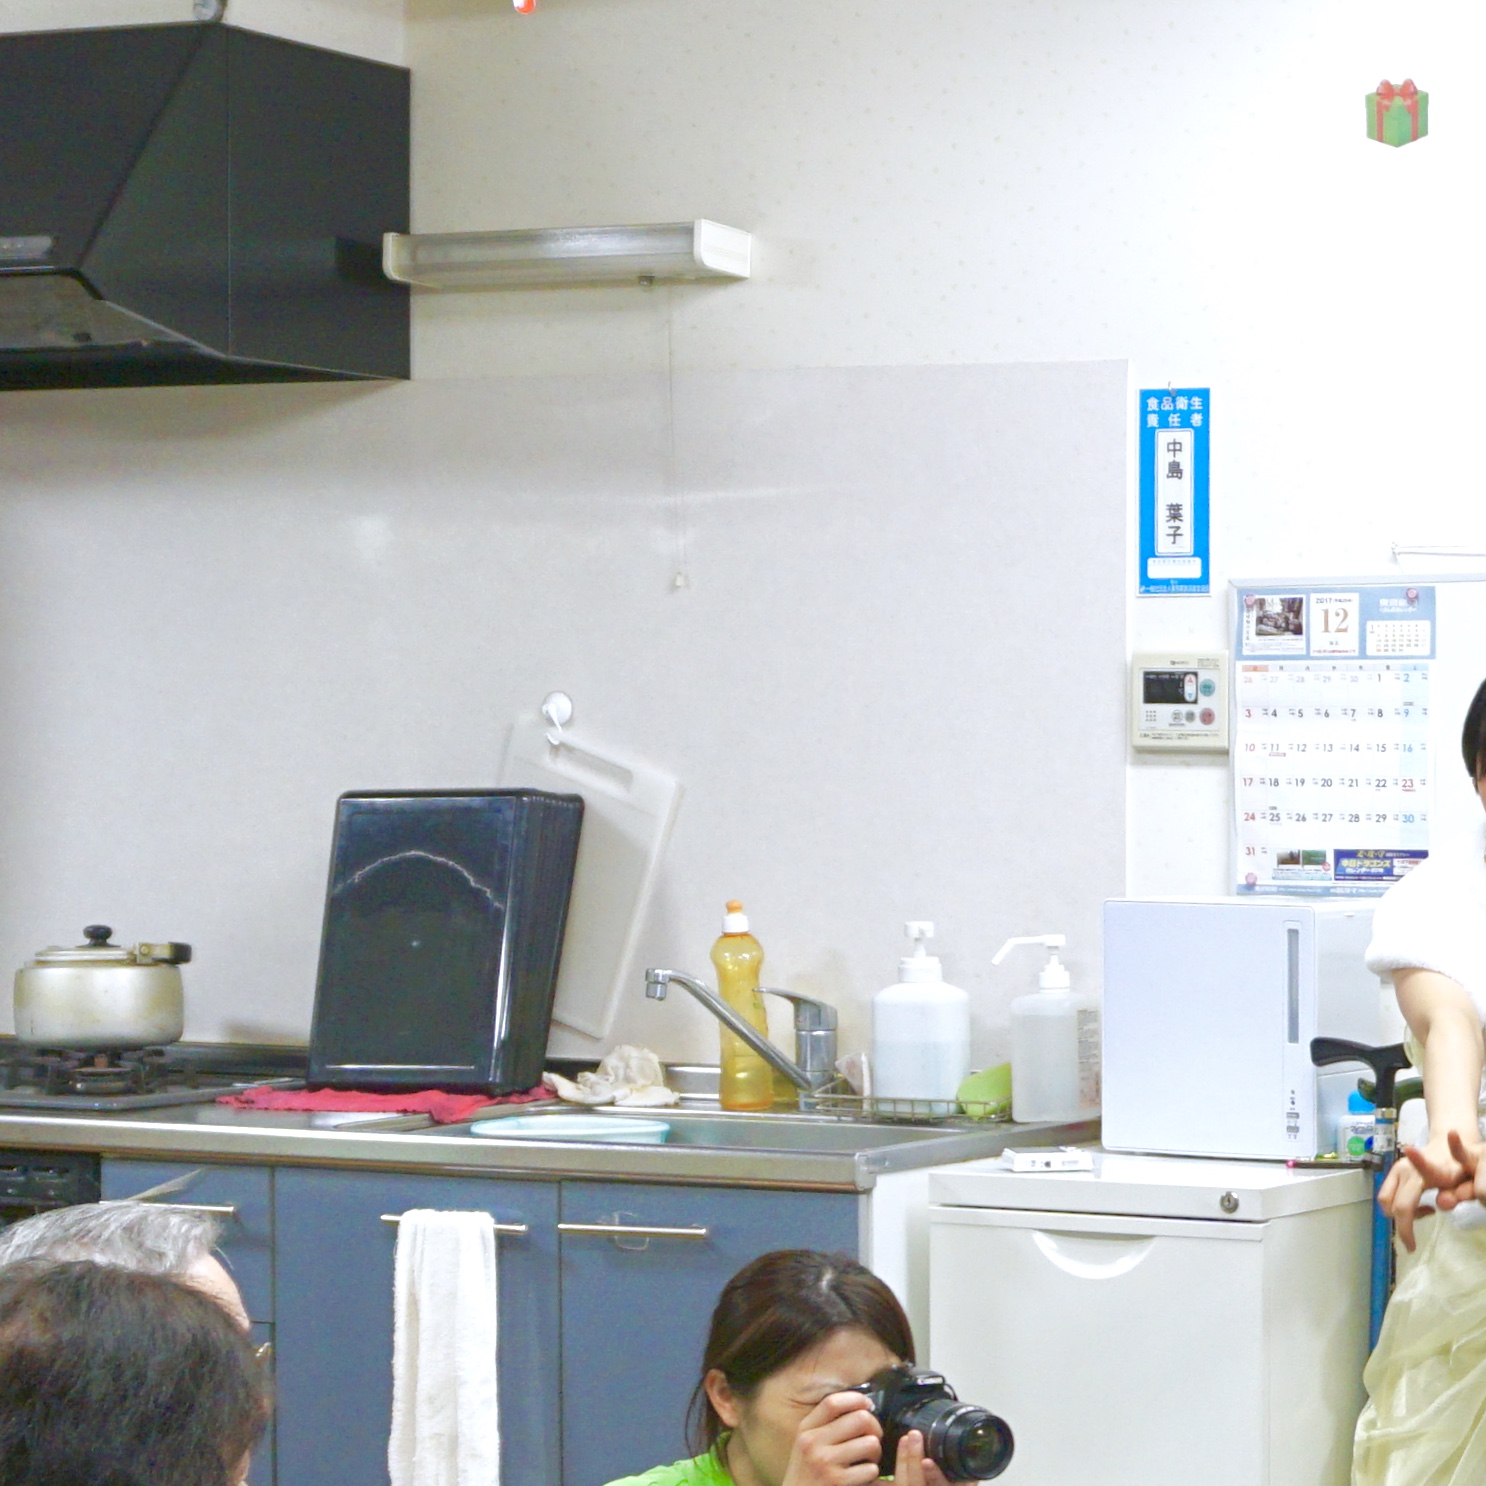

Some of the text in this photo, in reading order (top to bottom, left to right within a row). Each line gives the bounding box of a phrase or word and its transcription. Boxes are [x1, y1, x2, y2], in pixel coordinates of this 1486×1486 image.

[1146, 396, 1203, 411] 食品衛生
[1146, 412, 1203, 428] 責任者
[1166, 438, 1184, 480] 中島
[1165, 503, 1184, 545] 葉子
[1321, 607, 1349, 633] 12
[1245, 742, 1414, 753] 10 11 12 13 14 15 16
[1242, 777, 1414, 789] 17 18 19 20 21 22 23
[1244, 812, 1415, 824] 24 25 26 27 28 29 30
[1245, 846, 1256, 856] 31
